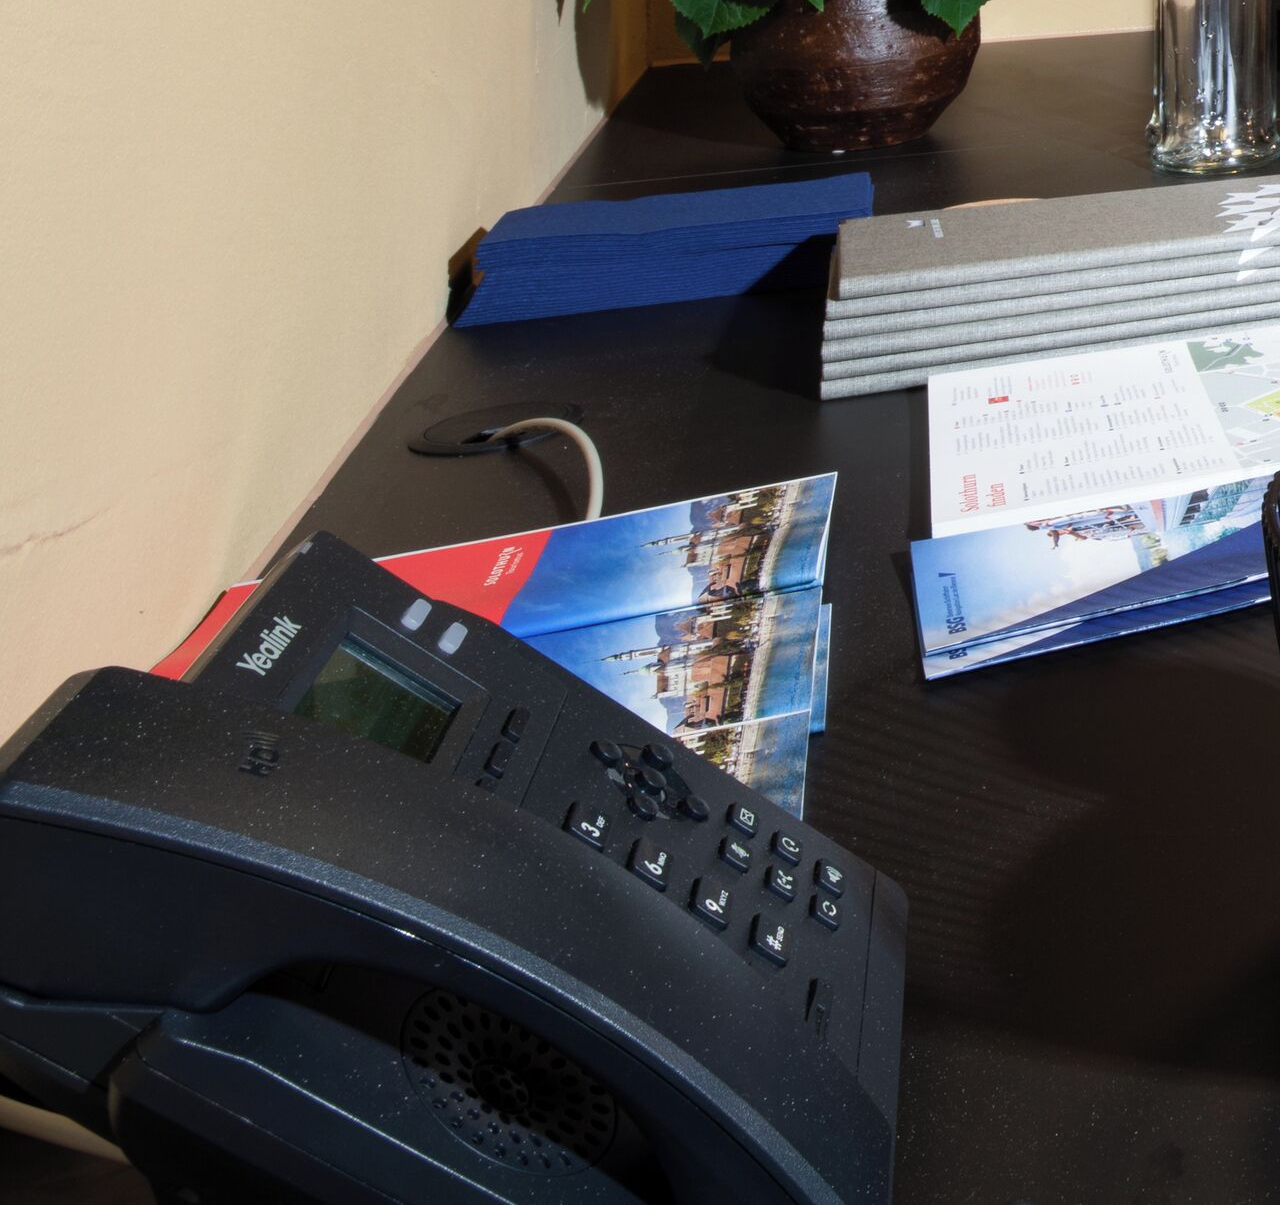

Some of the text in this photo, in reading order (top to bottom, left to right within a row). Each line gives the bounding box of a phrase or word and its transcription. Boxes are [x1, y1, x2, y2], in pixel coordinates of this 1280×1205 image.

[958, 473, 979, 513] Solothurn
[984, 482, 1007, 507] finden
[945, 616, 967, 635] BSG
[235, 614, 302, 677] Yealink
[580, 821, 601, 838] 3
[644, 859, 663, 875] 6
[705, 898, 724, 915] 9
